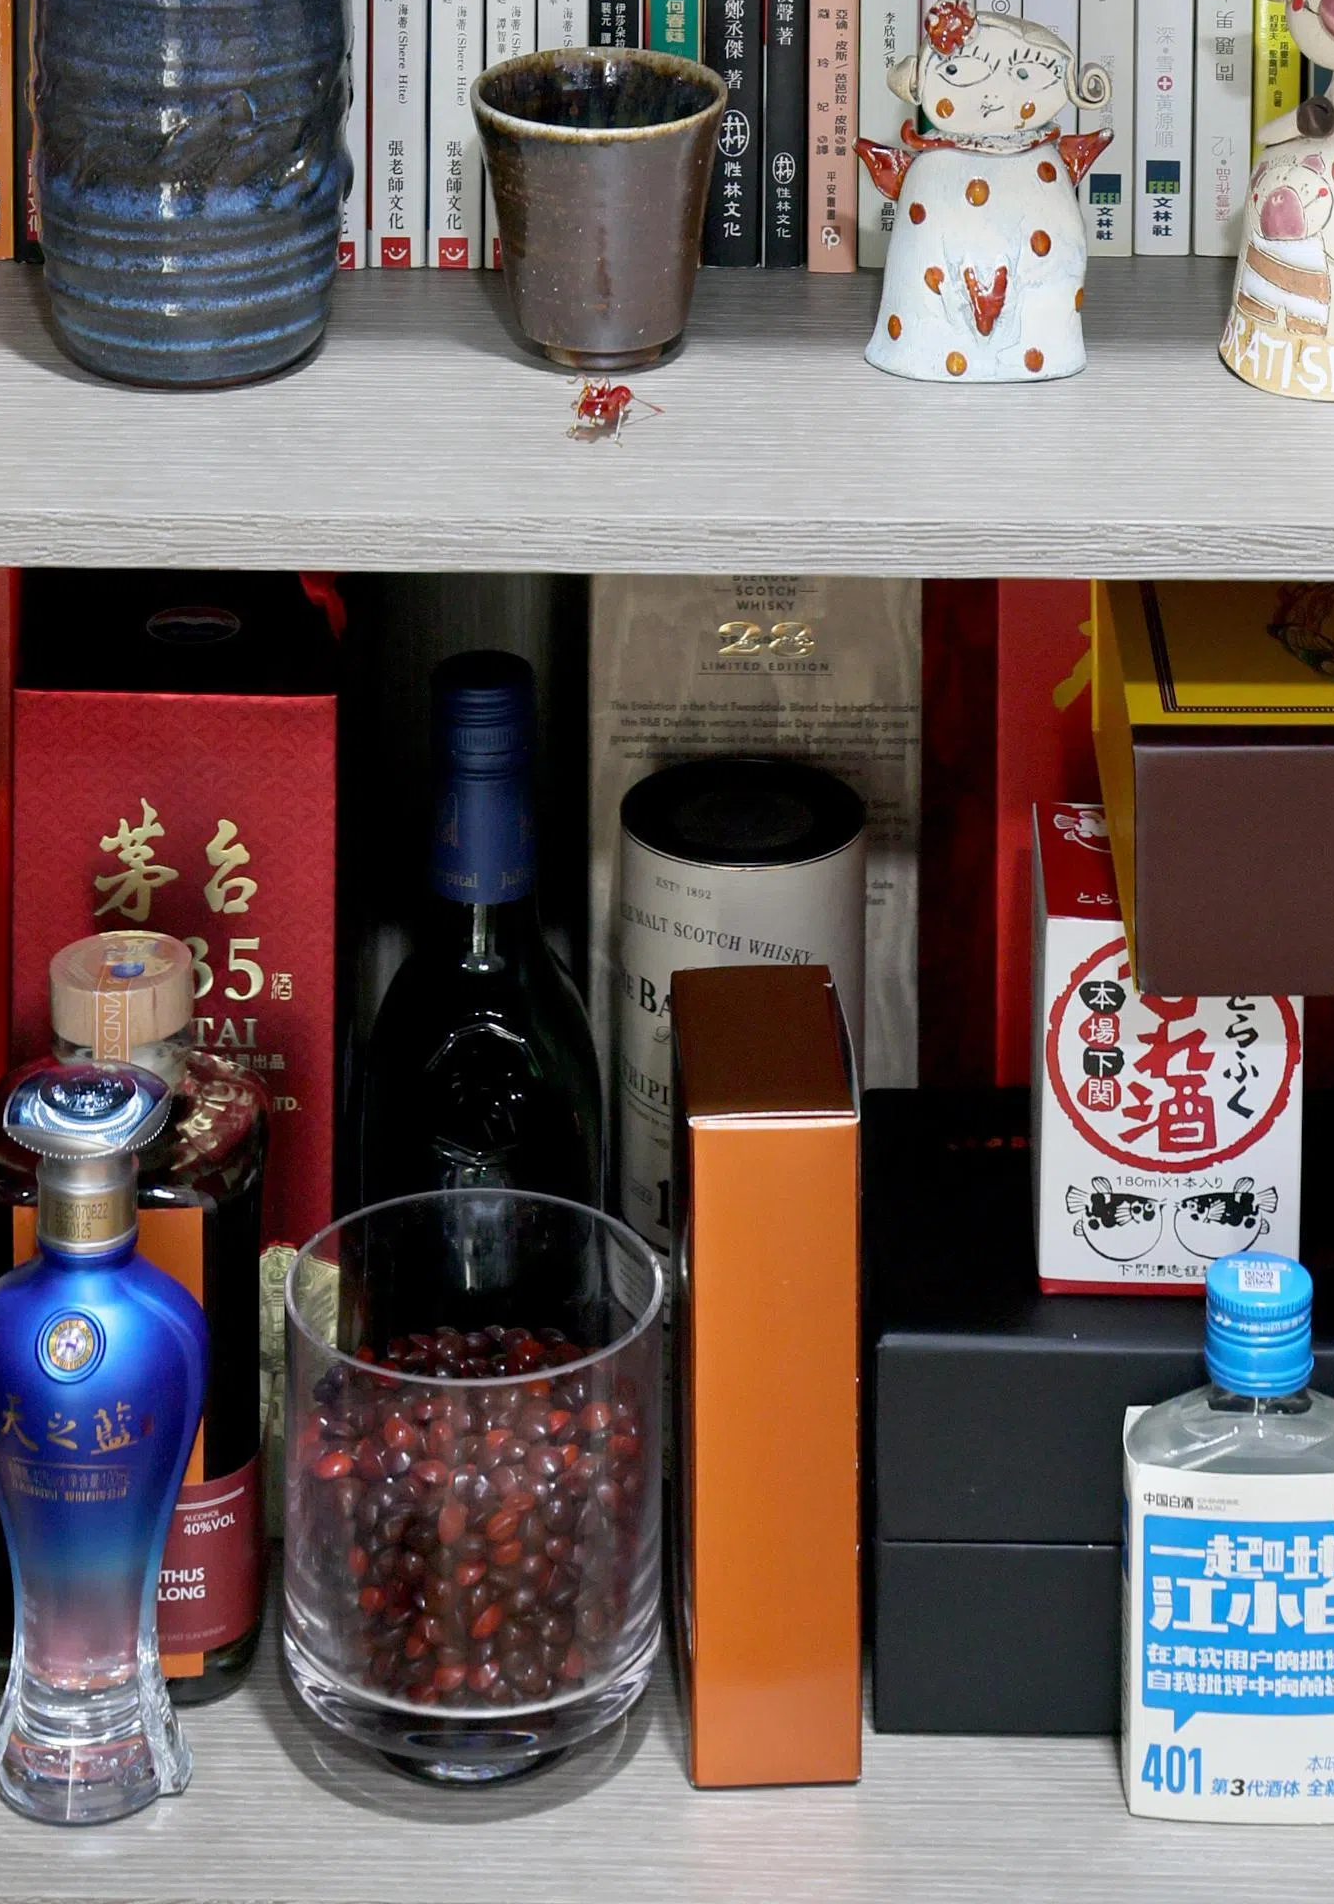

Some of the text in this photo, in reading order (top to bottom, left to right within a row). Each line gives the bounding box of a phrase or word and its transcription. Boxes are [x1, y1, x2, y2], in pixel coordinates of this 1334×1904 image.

[723, 0, 744, 90] 鄭丞傑 著
[776, 26, 794, 46] 著
[387, 140, 404, 231] 張老師文化
[445, 141, 463, 231] 張老師文化
[722, 160, 743, 238] 性林文化
[775, 186, 792, 239] 性林文化
[1152, 196, 1173, 237] 文林社
[735, 585, 797, 597] SCOTCH
[736, 600, 795, 611] WHISKY
[718, 621, 815, 659] 28
[701, 661, 829, 672] LIMITED EDITION
[93, 797, 258, 922] 茅台
[686, 885, 712, 900] 1892
[674, 921, 741, 952] SCOTCH
[748, 938, 814, 965] WHISKY
[1088, 983, 1118, 1107] 本場下関
[1143, 1492, 1194, 1510] 中国白酒
[183, 1512, 235, 1536] 40%VOL
[1141, 1743, 1202, 1796] 401
[1210, 1778, 1300, 1798] 第3代酒体
